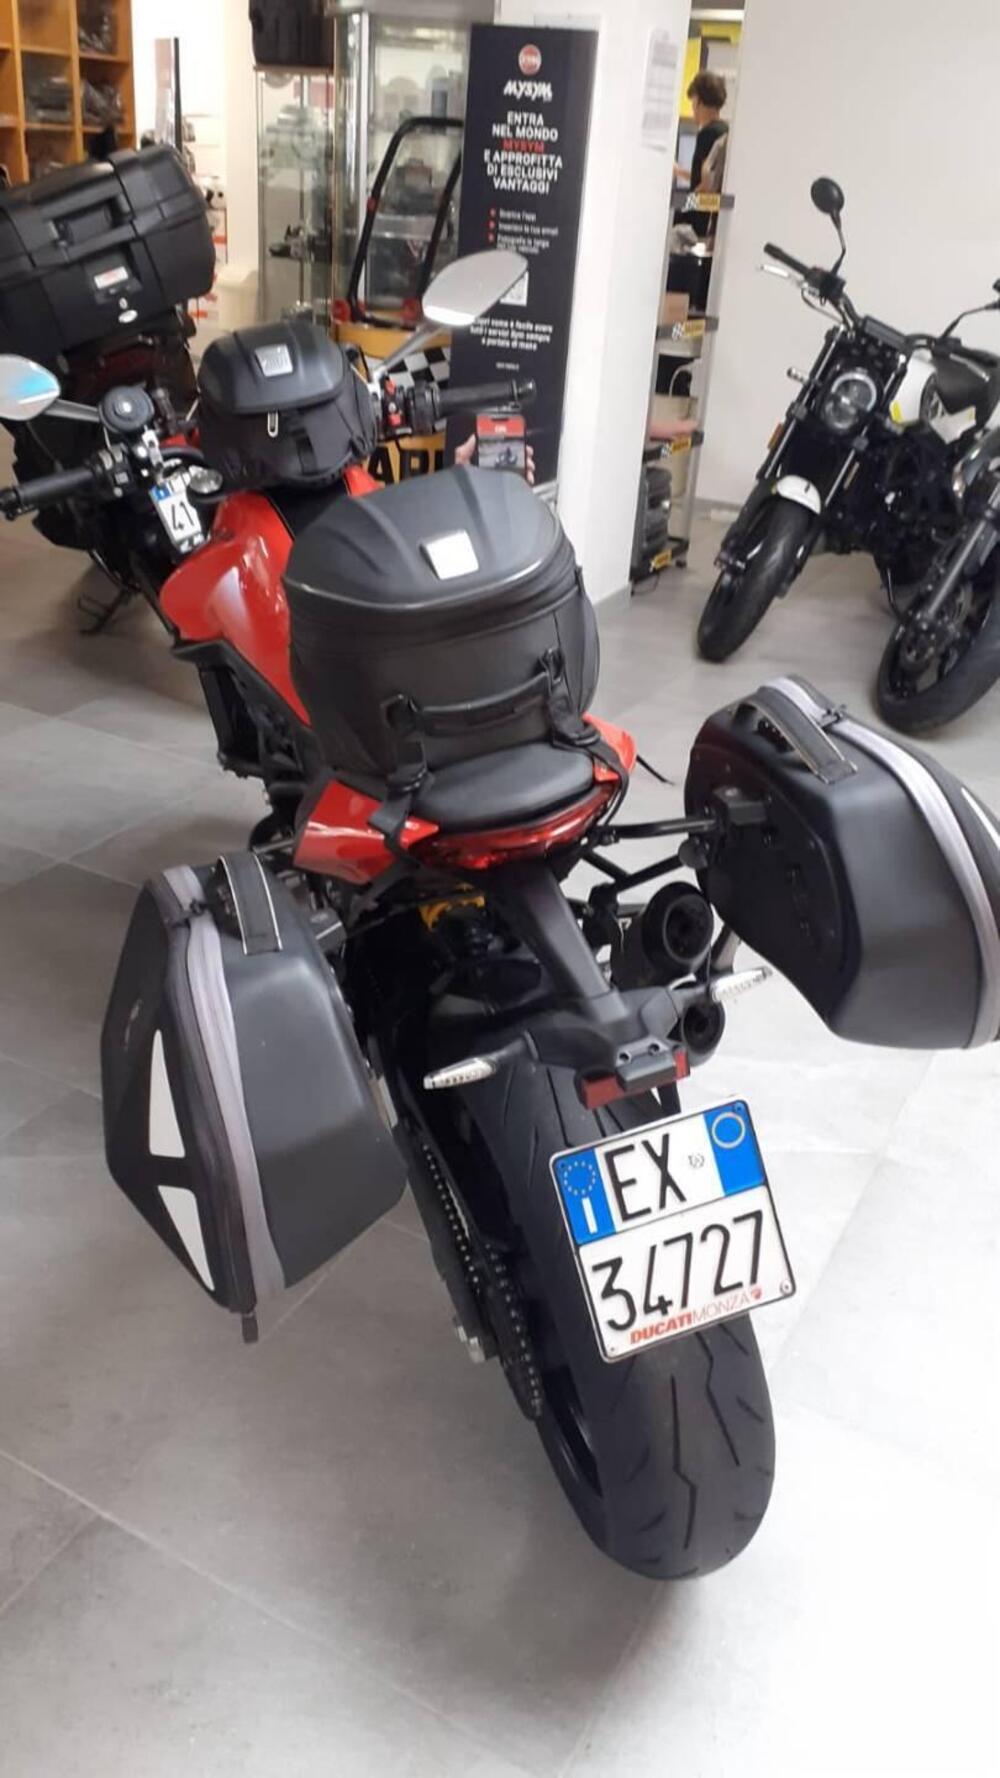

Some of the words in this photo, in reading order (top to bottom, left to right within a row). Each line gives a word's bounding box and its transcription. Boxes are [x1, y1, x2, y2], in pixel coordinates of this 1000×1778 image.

[507, 110, 544, 126] ENTRA
[492, 123, 513, 138] NEL
[516, 127, 558, 141] MONDO
[484, 149, 491, 162] E
[493, 150, 562, 169] APPROFITTA
[487, 163, 497, 176] DI
[501, 164, 558, 182] ESCLUSIVI
[493, 177, 549, 194] VANTAGGI
[604, 1133, 687, 1222] EX
[592, 1210, 763, 1331] 34727
